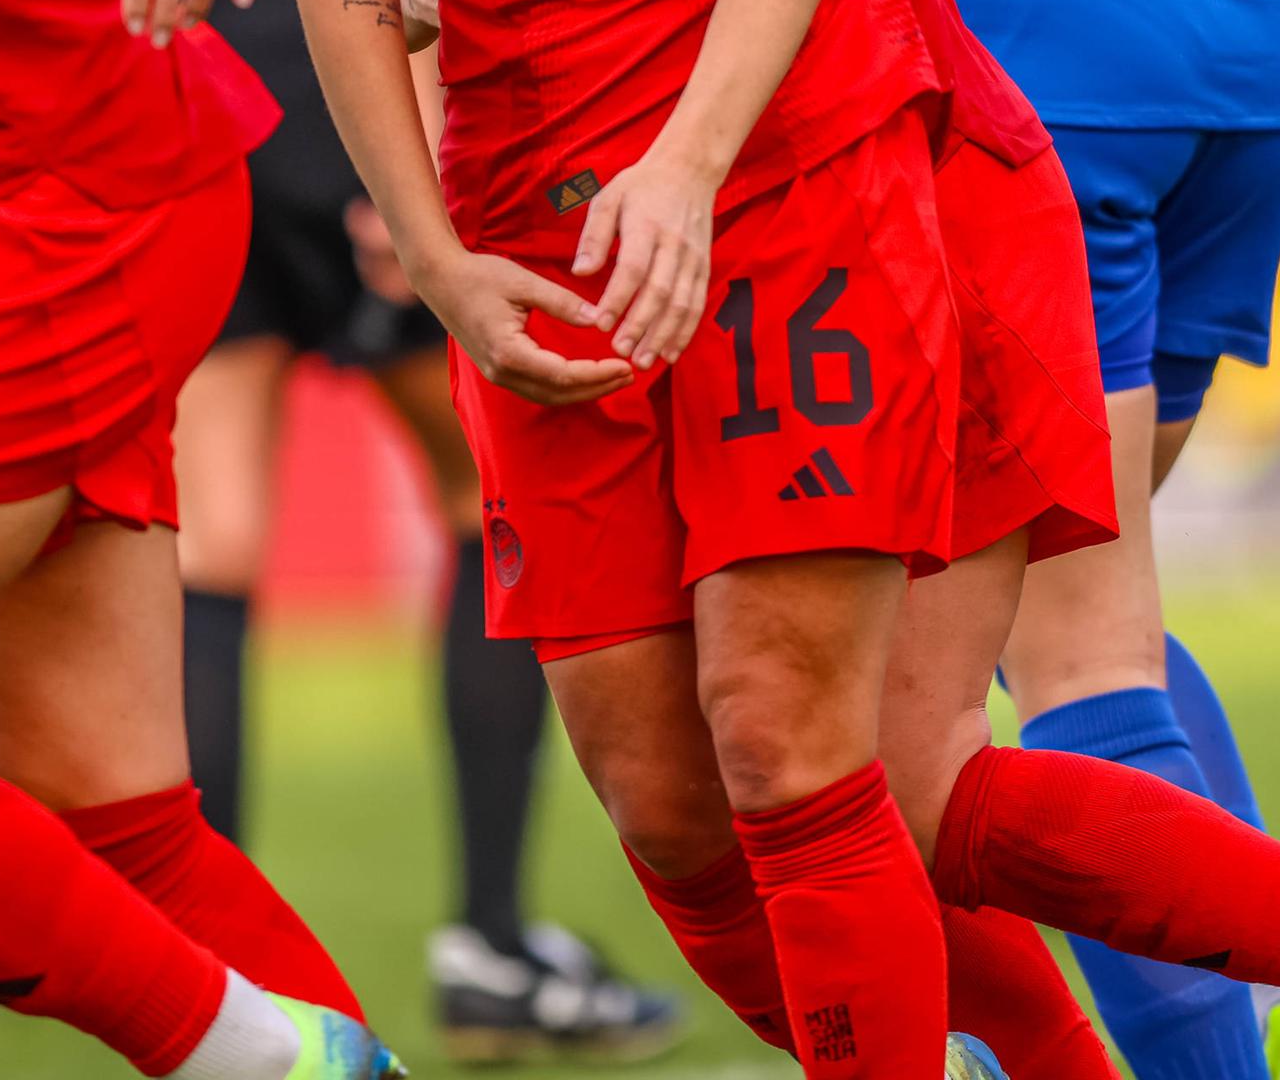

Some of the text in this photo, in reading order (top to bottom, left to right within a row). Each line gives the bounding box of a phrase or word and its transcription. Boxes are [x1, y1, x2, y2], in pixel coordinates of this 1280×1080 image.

[714, 267, 875, 442] 16
[804, 1003, 849, 1029] MIA
[814, 1039, 857, 1062] MIA
